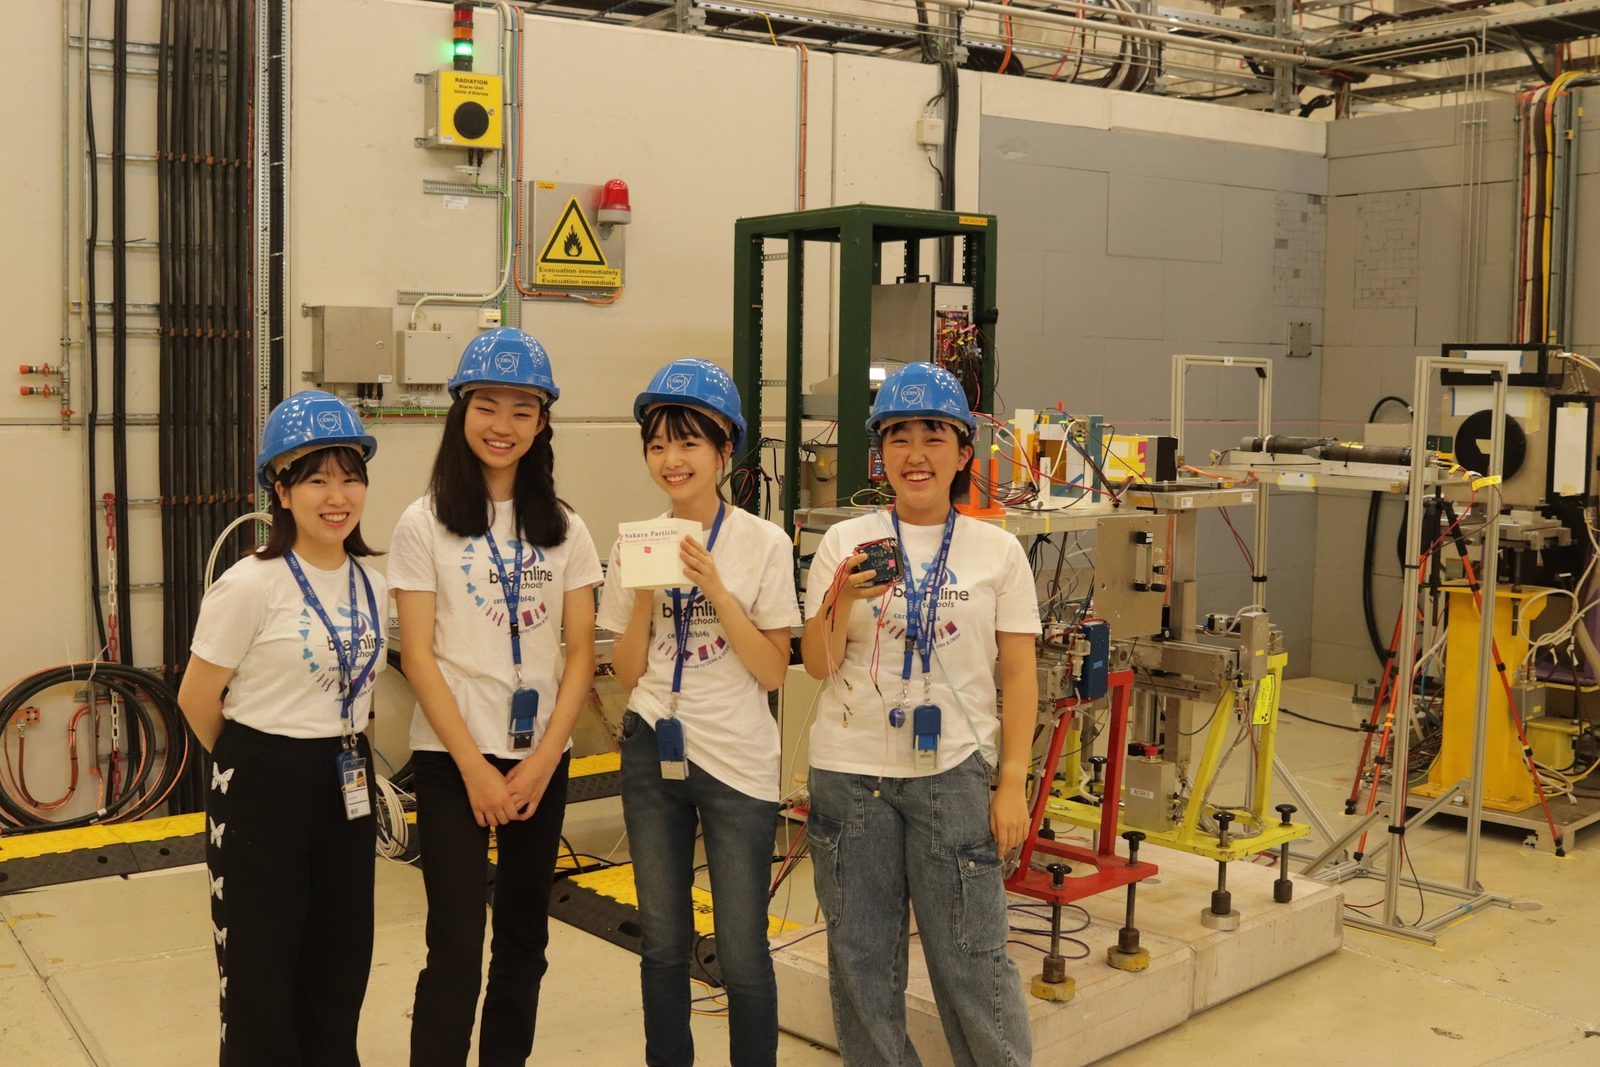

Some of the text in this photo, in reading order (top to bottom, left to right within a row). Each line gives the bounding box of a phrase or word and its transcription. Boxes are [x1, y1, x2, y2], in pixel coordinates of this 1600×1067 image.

[454, 77, 488, 86] RADIATION
[538, 266, 619, 277] Evacuation immediately
[689, 616, 721, 626] schools
